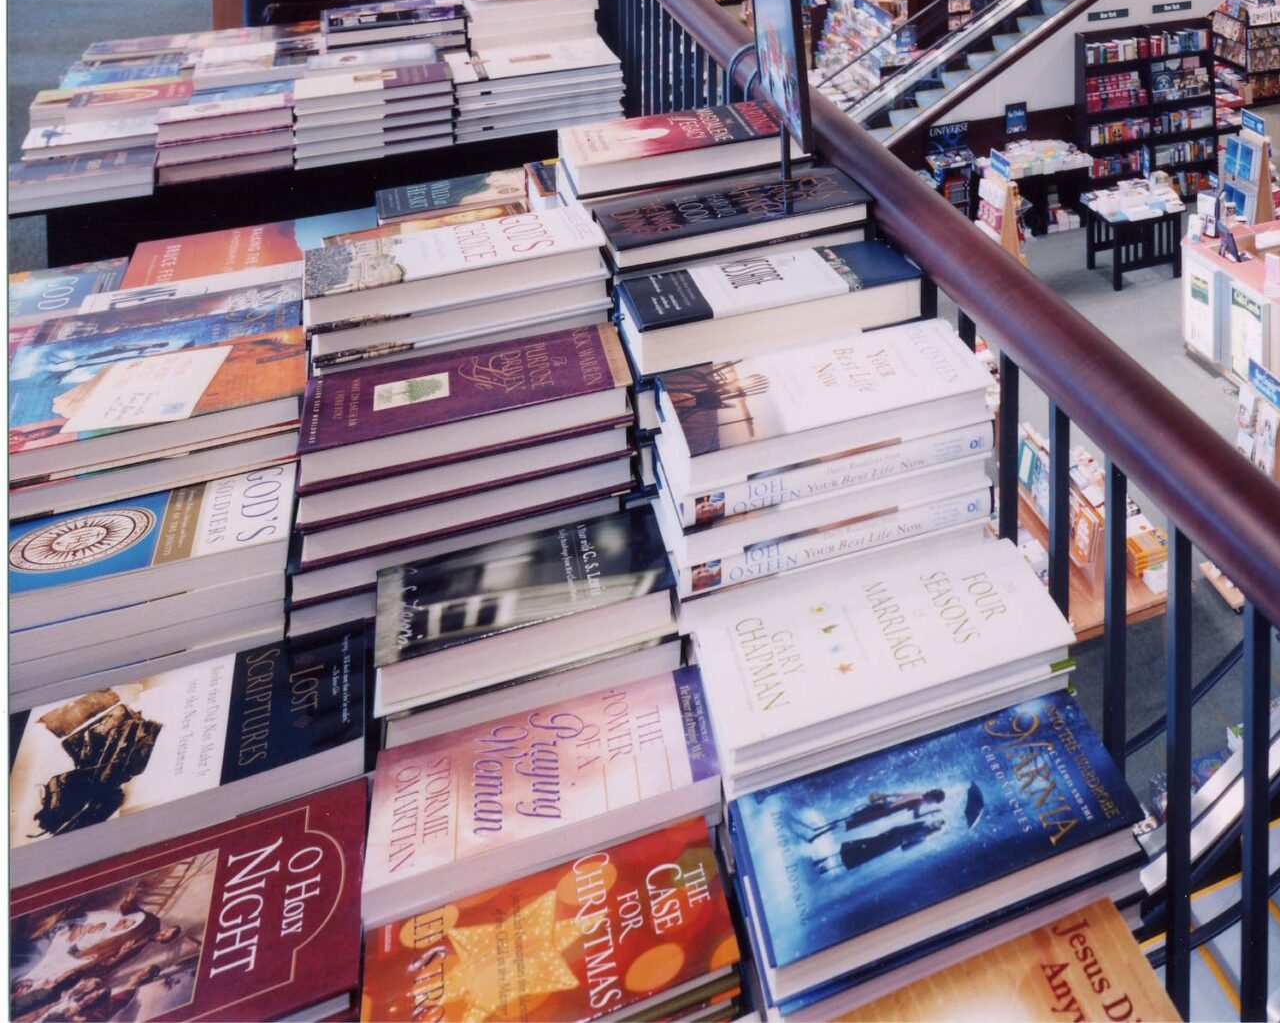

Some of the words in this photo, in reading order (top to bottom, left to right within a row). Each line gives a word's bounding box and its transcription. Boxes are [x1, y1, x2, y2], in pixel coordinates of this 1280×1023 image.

[695, 109, 734, 143] MAGDALENE
[929, 123, 969, 137] UNIVERSE
[407, 185, 428, 208] HEART
[161, 244, 182, 267] BRUCE
[454, 223, 497, 262] CHOICE
[500, 213, 554, 253] GOD'S
[719, 257, 783, 289] MESSAGE
[524, 342, 554, 390] PURPOSE
[867, 349, 896, 379] YOUR
[207, 480, 235, 545] SOLDIERS
[236, 467, 284, 542] GOD'S
[732, 488, 801, 515] OSTEEN
[841, 473, 867, 487] Best
[871, 466, 895, 481] Life
[583, 551, 596, 562] C.
[585, 562, 599, 572] S.
[729, 555, 797, 581] OSTEEN
[838, 538, 864, 552] Best
[868, 530, 893, 544] Life
[587, 572, 606, 596] Lewis
[920, 569, 980, 645] SEASONS
[961, 572, 1007, 622] FOUR
[863, 580, 927, 672] MARRIAGE
[735, 617, 790, 711] CHAPMAN
[771, 629, 807, 676] GARY
[239, 648, 280, 766] SCRIPTURES
[289, 664, 324, 713] LOST
[577, 724, 602, 750] OF
[603, 690, 633, 761] POWER
[636, 706, 664, 751] THE
[473, 725, 528, 837] Woman
[515, 712, 584, 820] Praying
[577, 755, 601, 770] A
[983, 712, 1079, 846] NARNIA
[1076, 752, 1121, 821] WARDROBE
[422, 756, 450, 845] STORMIE
[980, 745, 1032, 832] CHRONICLES
[1070, 787, 1083, 805] AND
[1079, 803, 1094, 822] THE
[389, 765, 422, 873] OMARTIAN
[287, 846, 323, 871] O
[210, 836, 283, 978] NIGHT
[280, 875, 321, 937] HOLY
[645, 863, 683, 935] CASE
[683, 862, 710, 907] THE
[785, 864, 810, 927] DOWNING
[414, 906, 445, 950] LEE
[571, 852, 622, 1010] CHRISTMAS
[617, 889, 644, 943] FOR
[1053, 919, 1110, 993] Jesus
